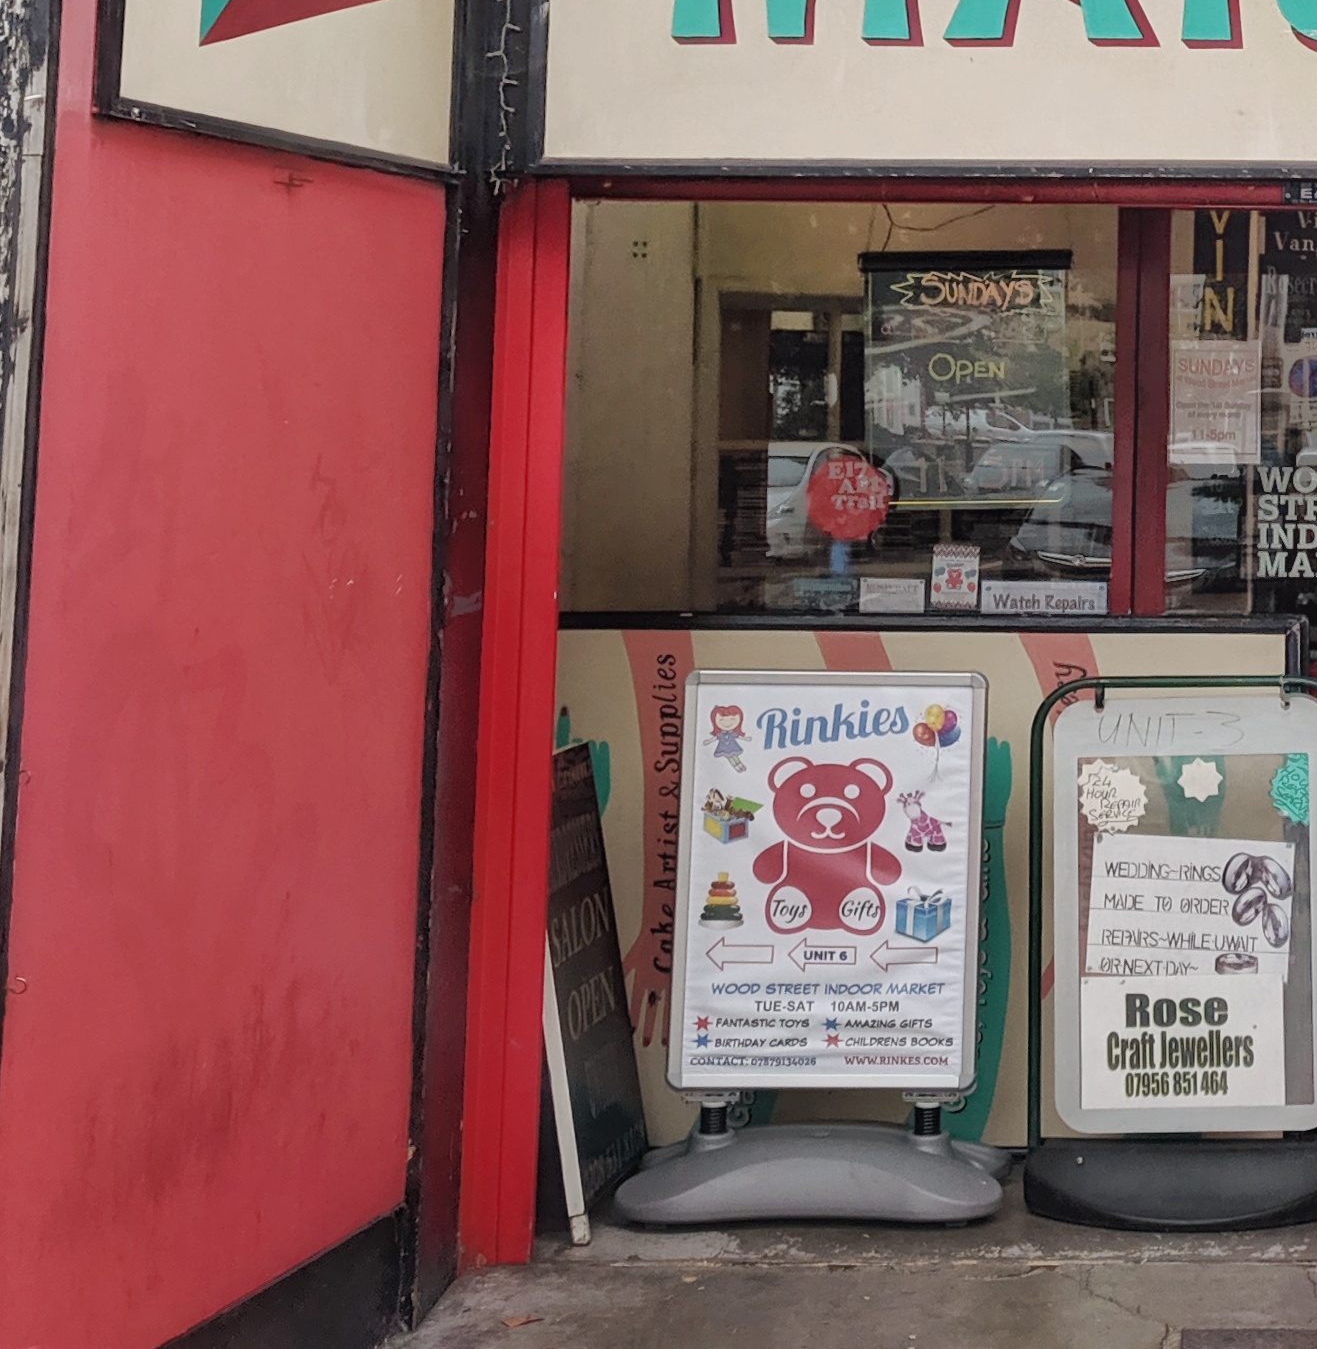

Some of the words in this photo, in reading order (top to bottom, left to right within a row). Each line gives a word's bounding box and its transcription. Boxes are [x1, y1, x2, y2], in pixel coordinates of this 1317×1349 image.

[1177, 358, 1255, 376] SUNDAYS
[993, 593, 1041, 610] Watch
[1045, 594, 1096, 613] Repairs
[652, 653, 682, 774] Supplies
[756, 699, 910, 750] Rinkies
[772, 899, 808, 923] Toys
[841, 899, 879, 920] Gifts
[1103, 893, 1145, 912] MADE
[551, 887, 611, 969] SALON
[803, 949, 836, 962] UNIT
[839, 949, 848, 962] 6
[711, 983, 761, 995] WOOD
[765, 983, 820, 995] STREET
[824, 983, 882, 995] INDOOR
[886, 982, 945, 995] MARKET
[568, 966, 616, 1041] OPEN
[754, 1000, 815, 1012] TUE-SAT
[831, 1000, 900, 1012] 10AM-5PM
[1125, 993, 1229, 1028] Rose
[715, 1018, 775, 1029] FANTASTIC
[780, 1018, 810, 1028] TOYS
[844, 1019, 896, 1029] AMAZING
[899, 1018, 933, 1029] GIFTS
[714, 1037, 766, 1048] BIRTHDAY
[769, 1037, 808, 1048] CARDS
[845, 1037, 907, 1047] CHILDRENS
[911, 1037, 954, 1047] BOOKS
[1107, 1031, 1156, 1071] Craft
[1159, 1029, 1255, 1070] Jewellers
[690, 1056, 749, 1067] CONTACT:
[1125, 1071, 1170, 1098] 07956
[1173, 1070, 1198, 1097] 851
[1200, 1070, 1229, 1096] 464
